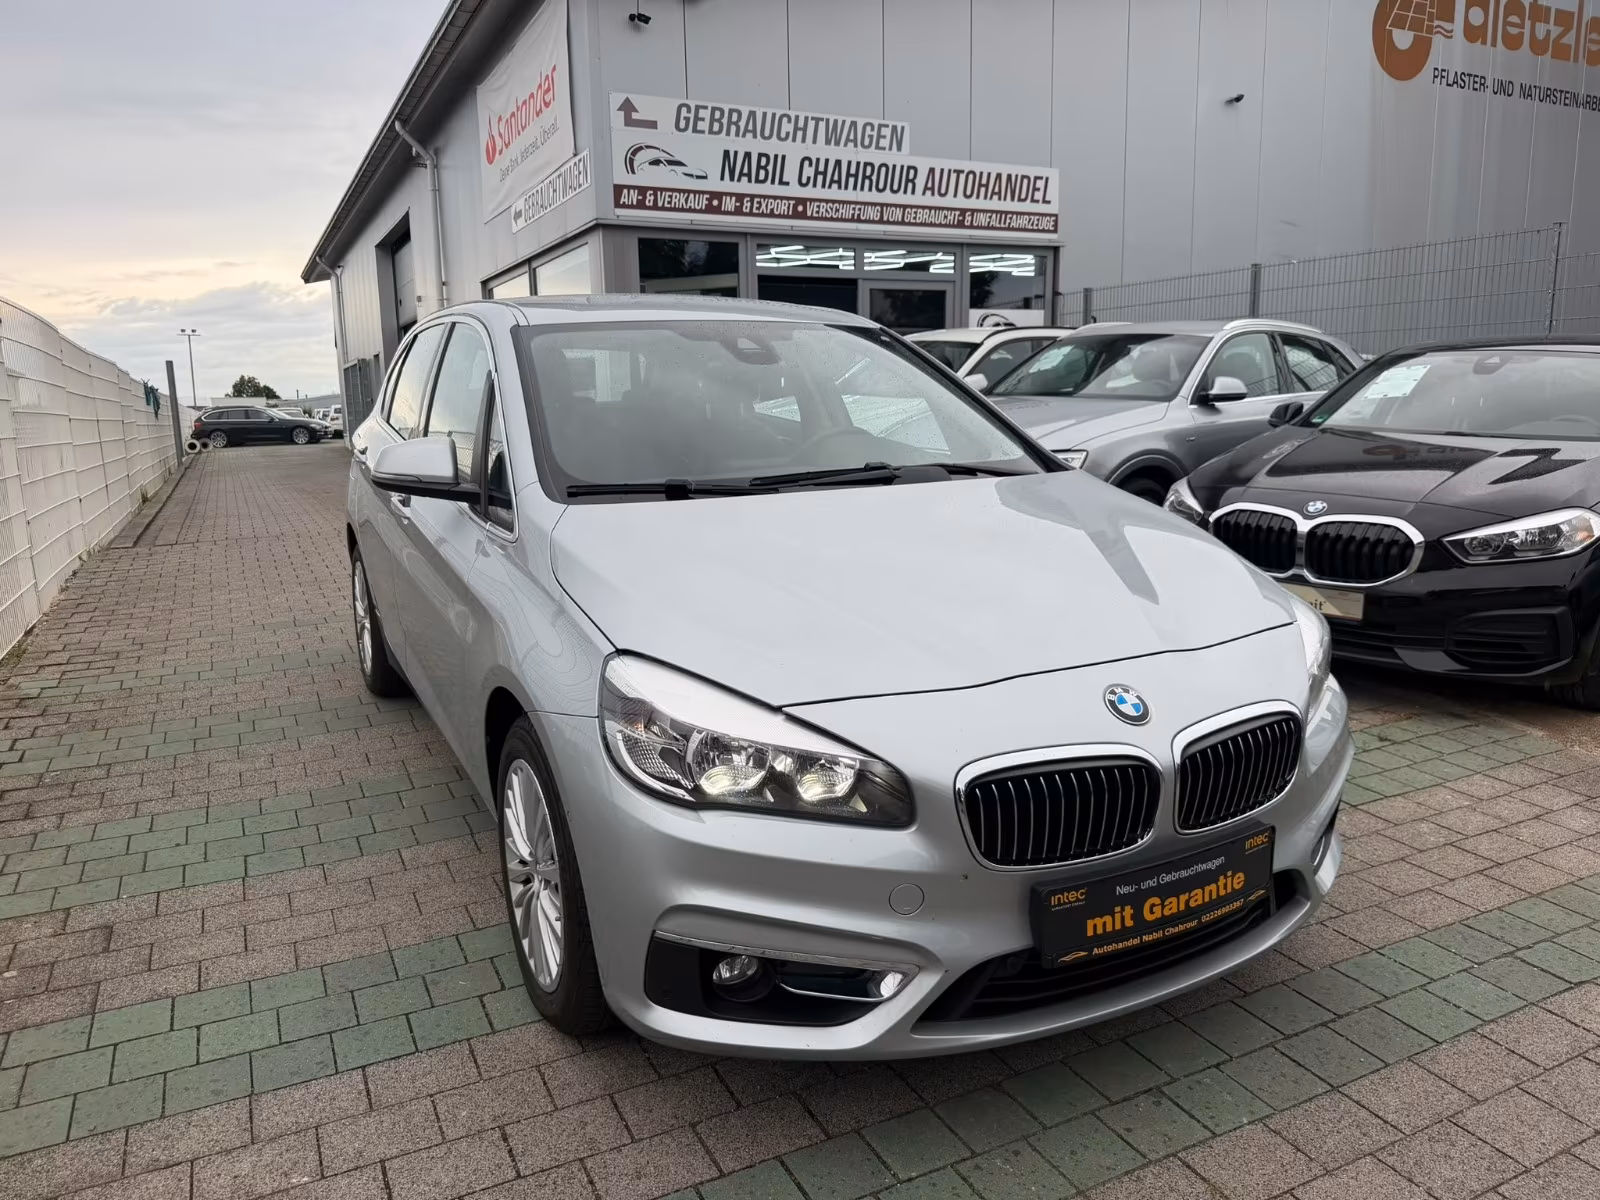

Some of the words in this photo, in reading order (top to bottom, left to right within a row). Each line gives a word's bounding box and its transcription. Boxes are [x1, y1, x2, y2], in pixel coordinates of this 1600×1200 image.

[1432, 67, 1489, 93] PFLASTER-
[1492, 78, 1515, 97] UND
[497, 64, 557, 156] Santander
[674, 102, 905, 153] GEBRAUCHTWAGEN
[524, 153, 588, 223] GEBRAUCHTWAGEN
[720, 149, 790, 187] NABIL
[797, 156, 918, 196] CHAHROUR
[922, 166, 1052, 204] AUTOHANDEL
[620, 188, 643, 206] AN-
[646, 190, 654, 207] &
[657, 191, 710, 211] VERKAUF
[721, 196, 740, 212] IM-
[743, 198, 751, 213] &
[752, 198, 796, 216] EXPORT
[806, 200, 881, 221] VERSCHIFFUNG
[883, 205, 903, 222] VON
[904, 207, 963, 225] GEBRAUCHT-
[964, 211, 972, 226] &
[973, 212, 1056, 231] UNFALLFAHRZEUGE
[1116, 884, 1139, 896] Neu-
[1141, 876, 1158, 890] und
[1159, 855, 1225, 885] Gebrauchtwagen
[1086, 905, 1134, 937] mit
[1143, 870, 1245, 921] Garantie
[1092, 937, 1140, 956] Autohandel
[1142, 930, 1163, 943] Nabil
[1164, 919, 1199, 936] Chahrour
